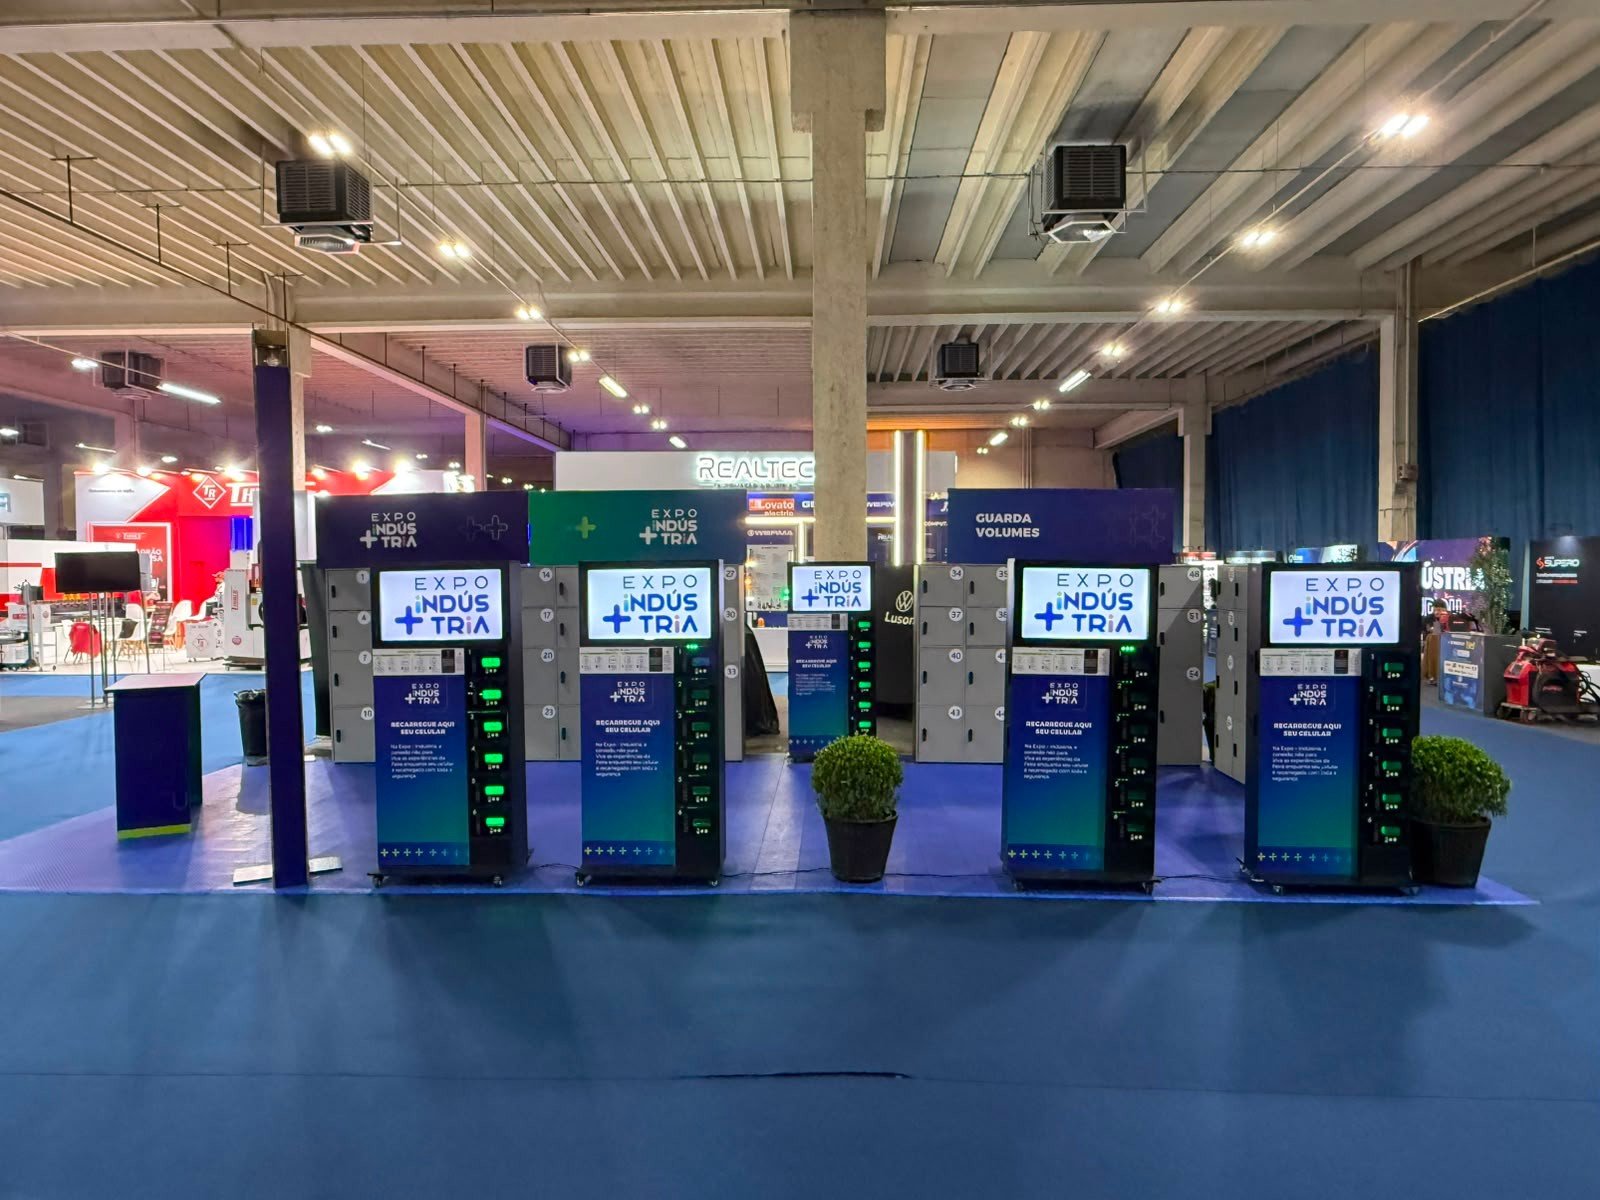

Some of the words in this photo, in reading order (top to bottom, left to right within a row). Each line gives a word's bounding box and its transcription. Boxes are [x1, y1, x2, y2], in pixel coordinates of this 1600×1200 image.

[757, 499, 794, 509] Lovato
[371, 512, 416, 522] EXPO
[651, 509, 697, 518] EXPO
[976, 513, 1031, 523] GUARDA
[976, 528, 1040, 538] VOLUMES
[814, 570, 861, 579] EXPO
[415, 576, 488, 590] EXPO
[623, 574, 697, 589] EXPO
[1057, 573, 1133, 588] EXPO
[1306, 577, 1384, 591] EXPO
